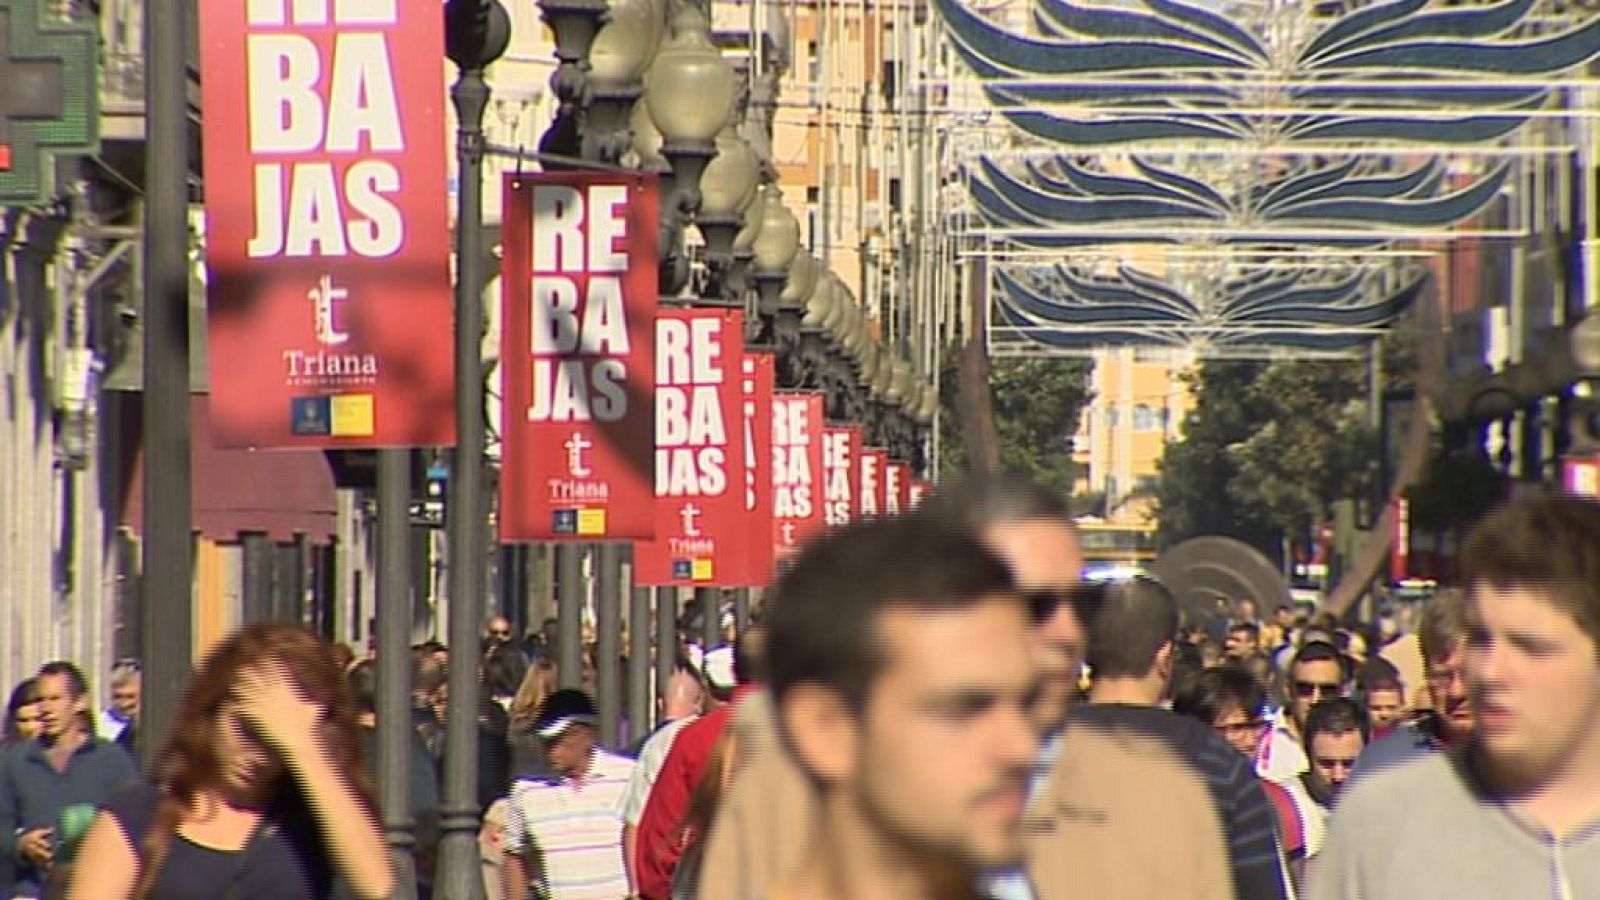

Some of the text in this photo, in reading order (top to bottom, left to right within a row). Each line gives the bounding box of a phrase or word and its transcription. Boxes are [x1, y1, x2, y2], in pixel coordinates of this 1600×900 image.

[247, 32, 404, 153] BA
[247, 161, 403, 258] JAS
[532, 185, 628, 272] RE
[530, 276, 630, 355] BA
[282, 349, 377, 376] Triana
[654, 317, 723, 384] RE
[527, 359, 628, 422] JAS
[654, 386, 727, 448] BA
[548, 480, 609, 499] Triana
[774, 487, 812, 517] AS
[668, 538, 715, 554] Triana
